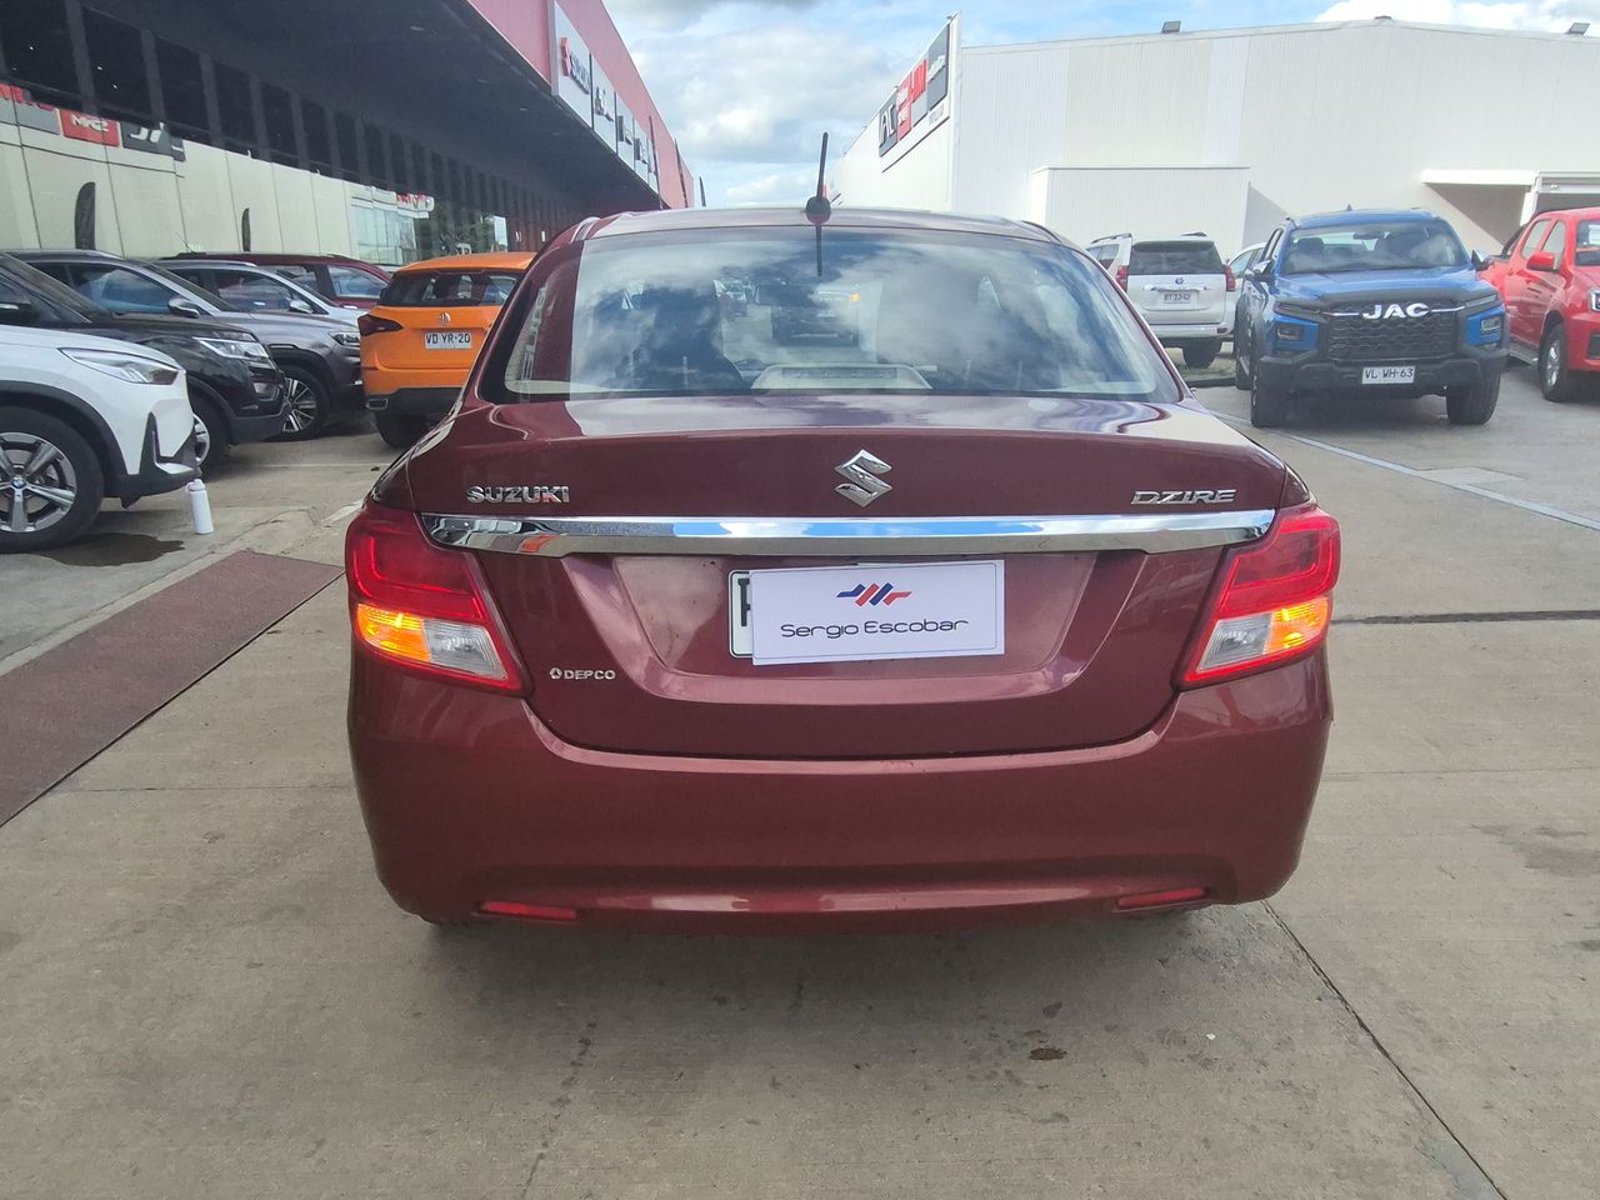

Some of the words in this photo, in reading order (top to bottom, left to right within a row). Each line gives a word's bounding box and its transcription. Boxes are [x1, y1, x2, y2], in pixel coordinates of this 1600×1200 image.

[1362, 303, 1429, 320] JAC
[426, 333, 439, 344] VD
[466, 485, 570, 503] SUZUKI
[1130, 489, 1237, 505] DZIRE
[780, 623, 860, 640] Sergio
[864, 618, 969, 635] Escobar
[564, 669, 617, 680] DEPCO
